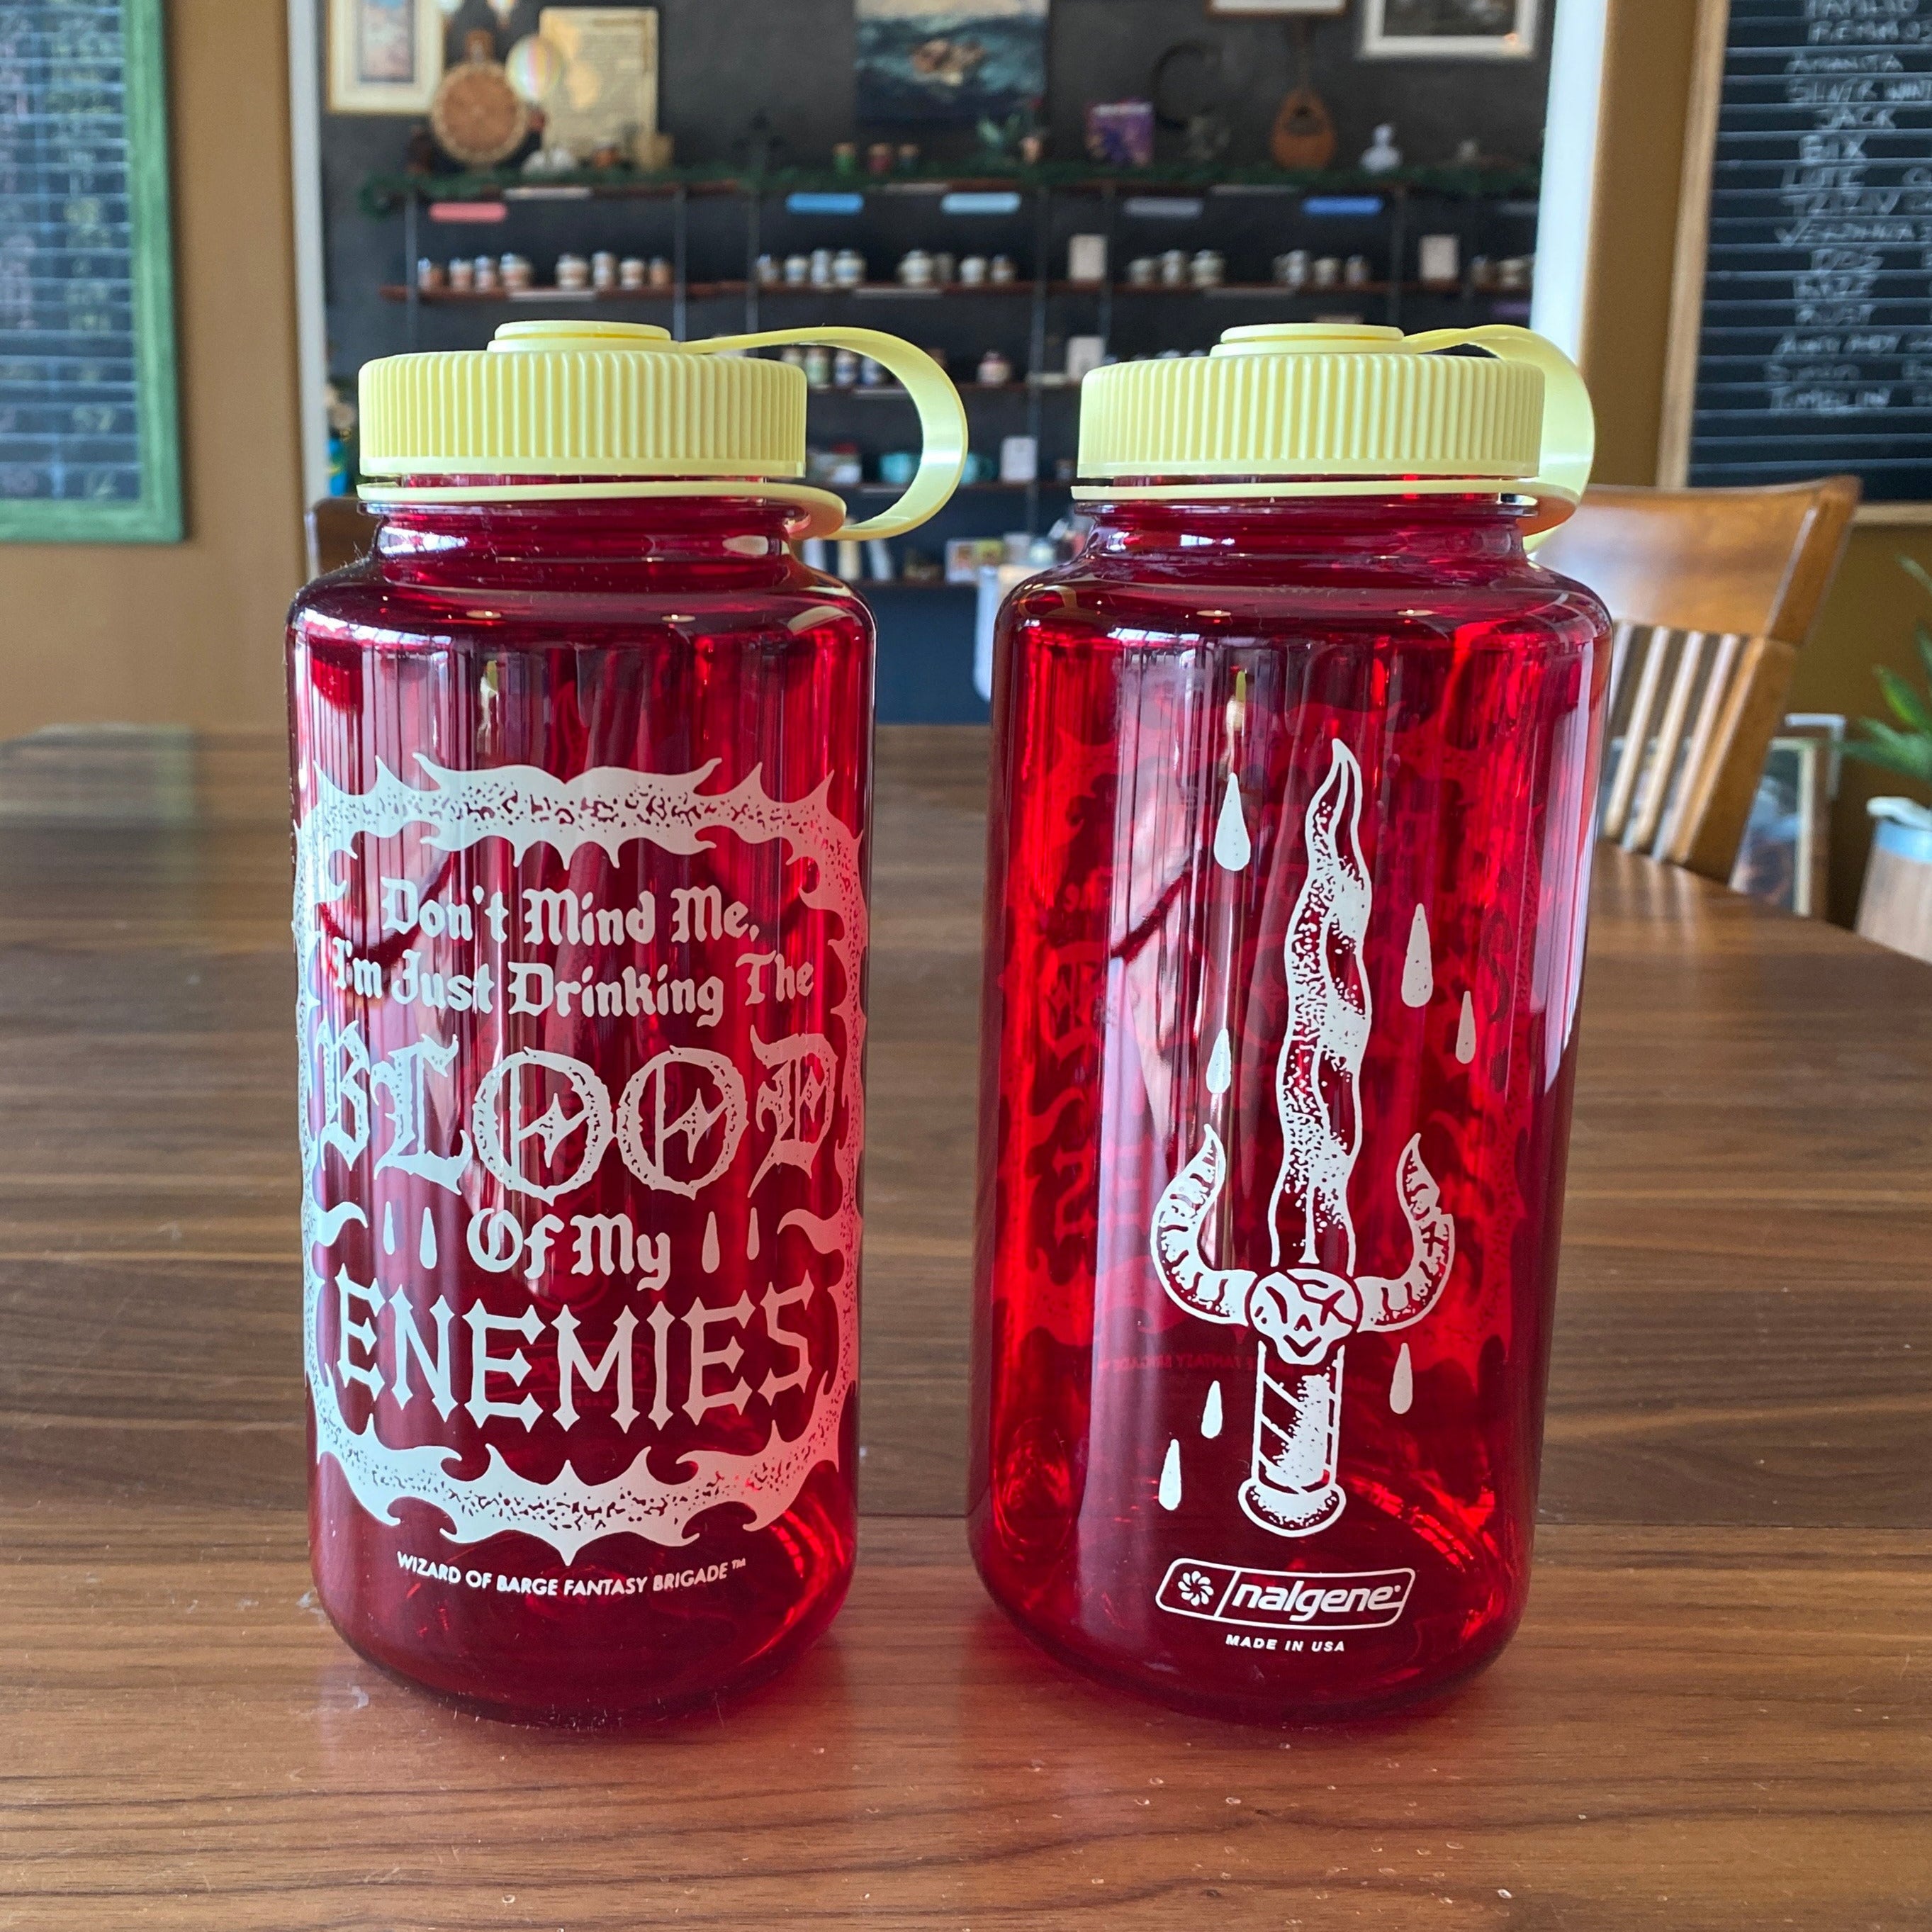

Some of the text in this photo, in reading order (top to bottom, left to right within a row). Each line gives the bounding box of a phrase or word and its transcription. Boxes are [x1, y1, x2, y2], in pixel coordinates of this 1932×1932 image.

[381, 877, 508, 943] Don't
[523, 886, 656, 946] Mind
[332, 936, 815, 1027] I'm Just Drinking The
[313, 1018, 837, 1206] BLOOD
[466, 1208, 671, 1292] Of My
[335, 1263, 814, 1433] ENEMIES
[396, 1550, 461, 1585] WIZARD
[465, 1570, 493, 1589] OF
[496, 1574, 558, 1596] BARGE
[563, 1576, 648, 1597] FANTASY
[652, 1562, 729, 1592] BRIGADE
[1225, 1634, 1345, 1653] MADE IN USA
